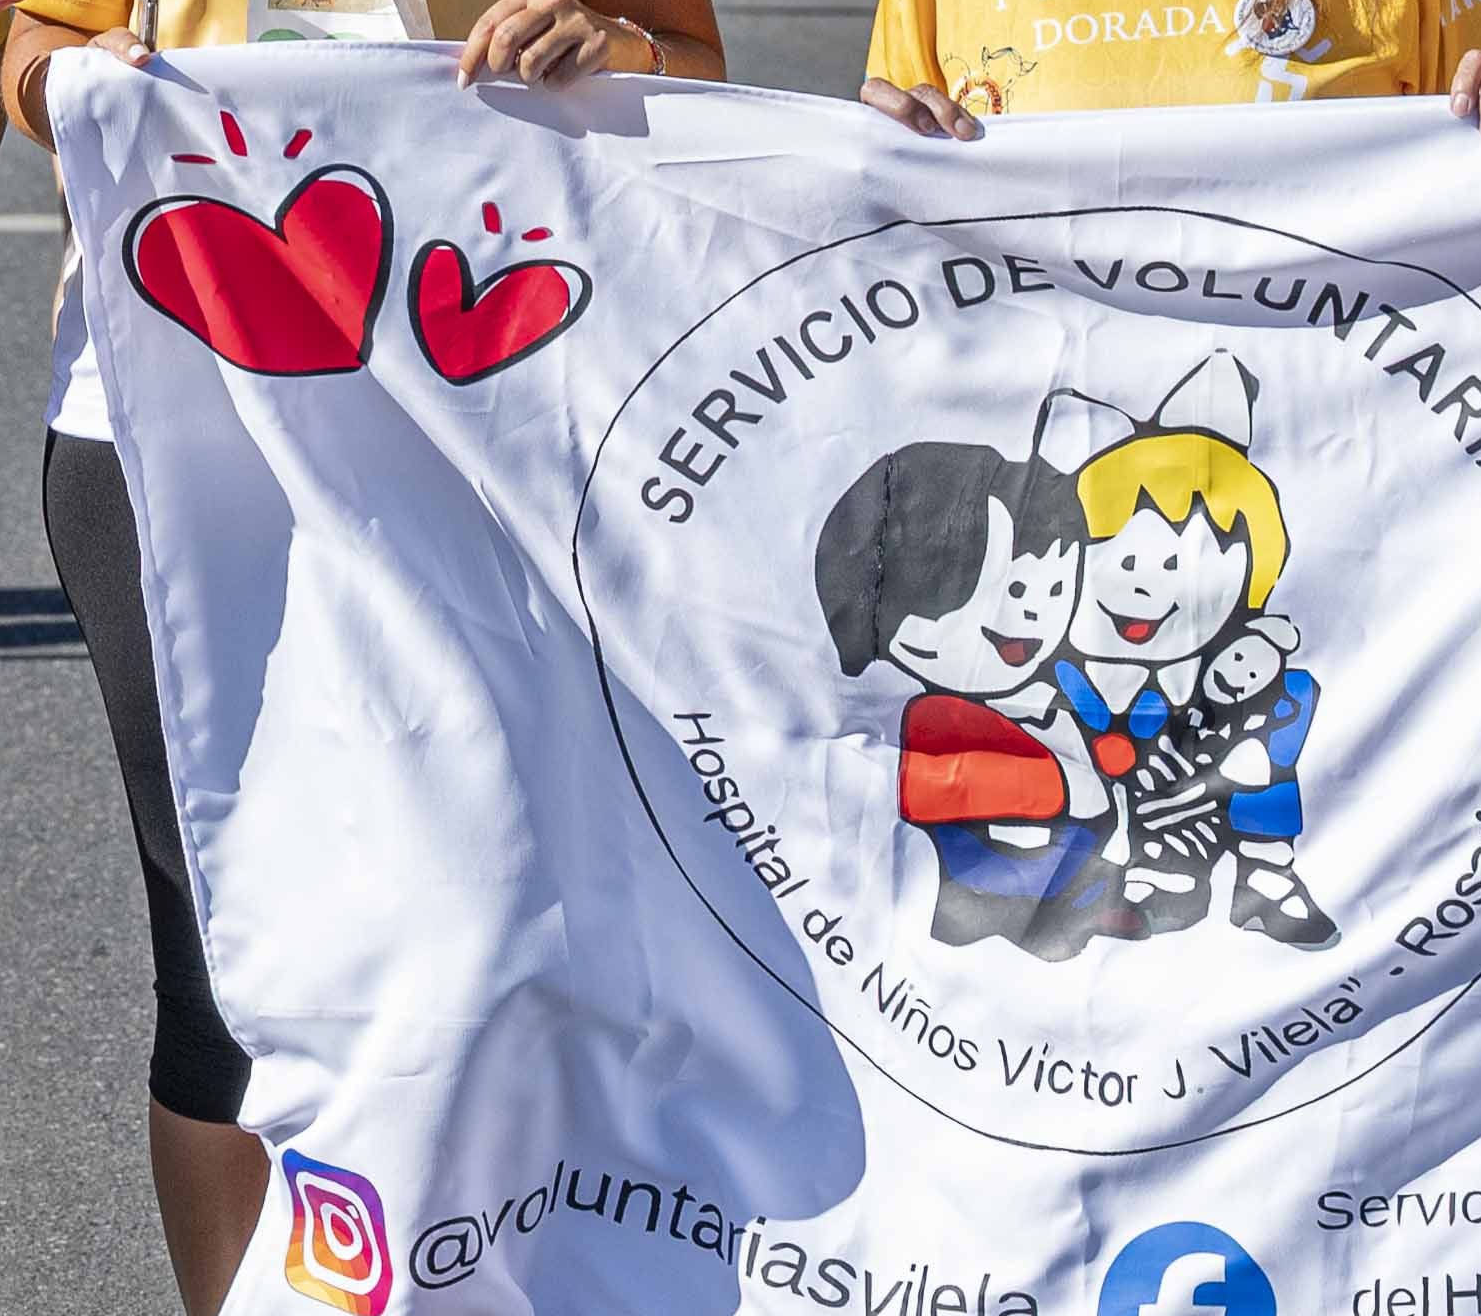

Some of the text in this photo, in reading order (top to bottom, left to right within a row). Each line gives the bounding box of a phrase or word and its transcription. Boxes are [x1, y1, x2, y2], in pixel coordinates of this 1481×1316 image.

[1032, 4, 1225, 52] DORADA
[641, 279, 919, 524] SERVICIO
[942, 254, 1055, 308] DE
[673, 713, 809, 898] Hospital
[803, 908, 854, 966] de
[861, 962, 979, 1071] Niños
[1163, 1059, 1204, 1100] J.
